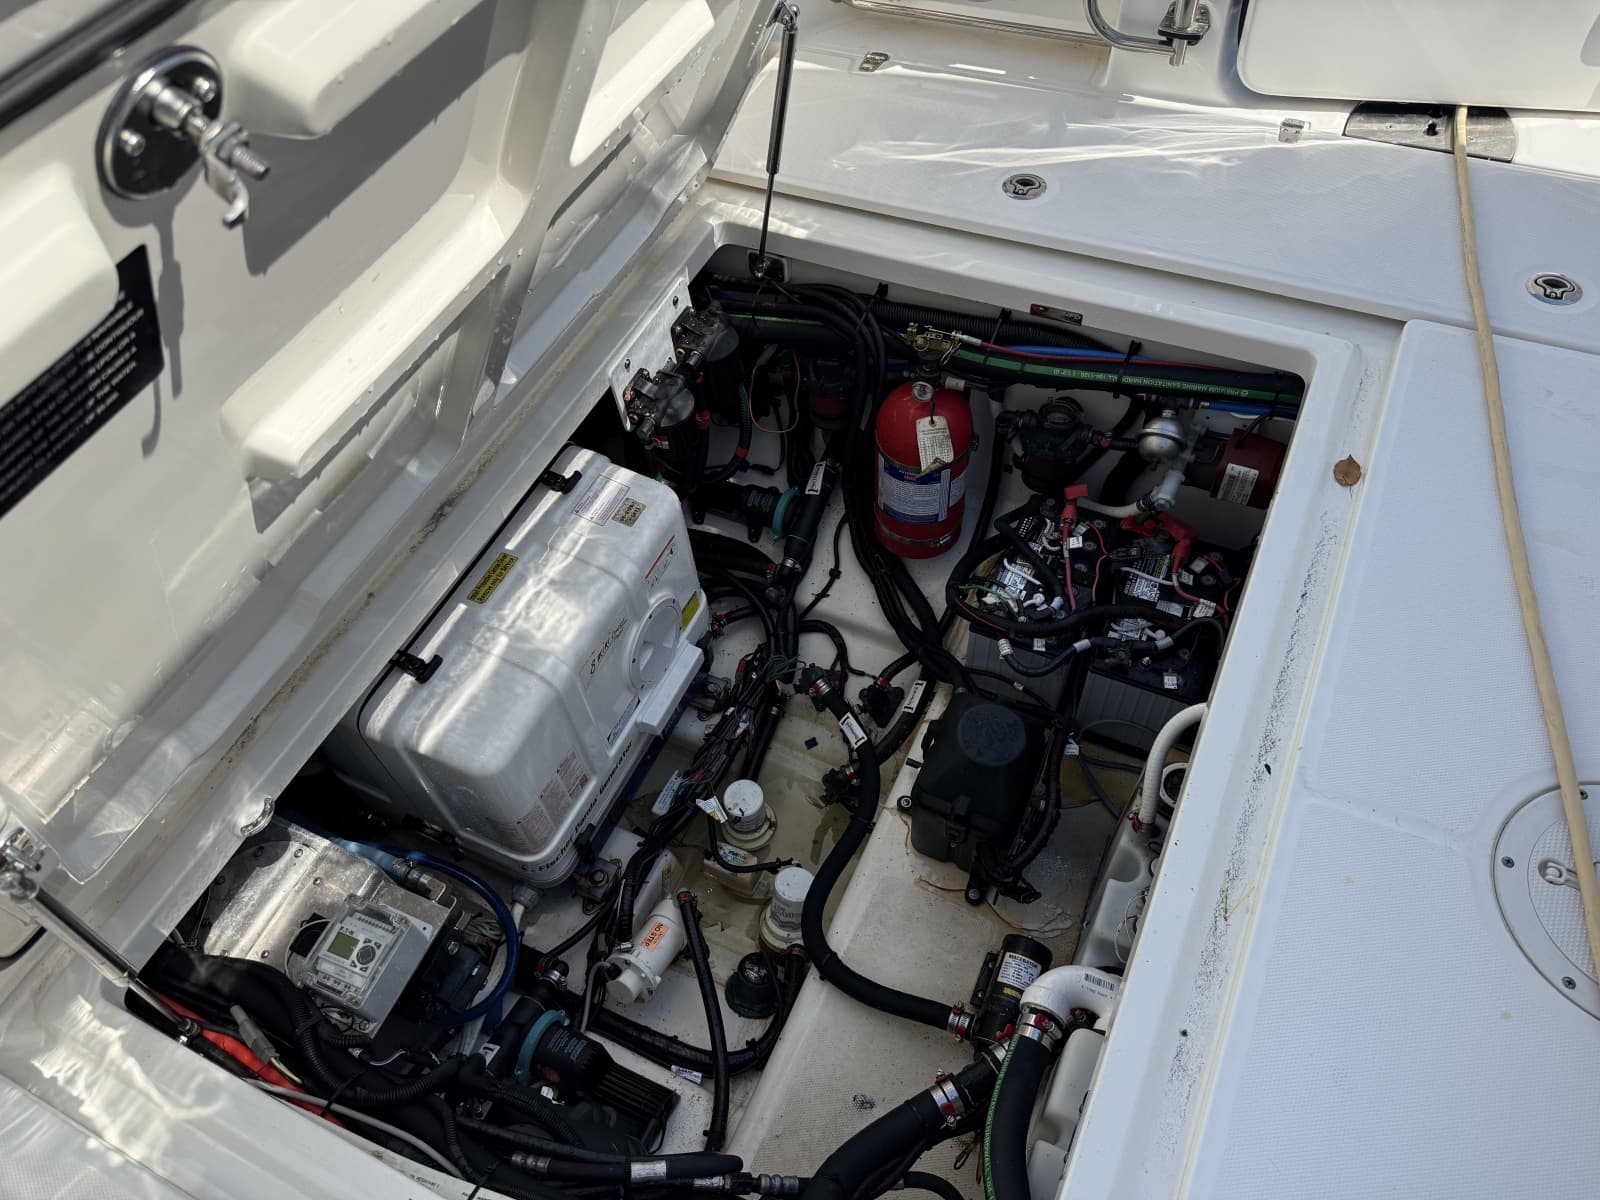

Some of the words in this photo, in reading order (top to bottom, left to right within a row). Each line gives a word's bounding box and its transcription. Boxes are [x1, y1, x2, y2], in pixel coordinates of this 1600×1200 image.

[600, 740, 632, 795] Generator
[654, 922, 664, 932] NO
[645, 932, 658, 947] STEP
